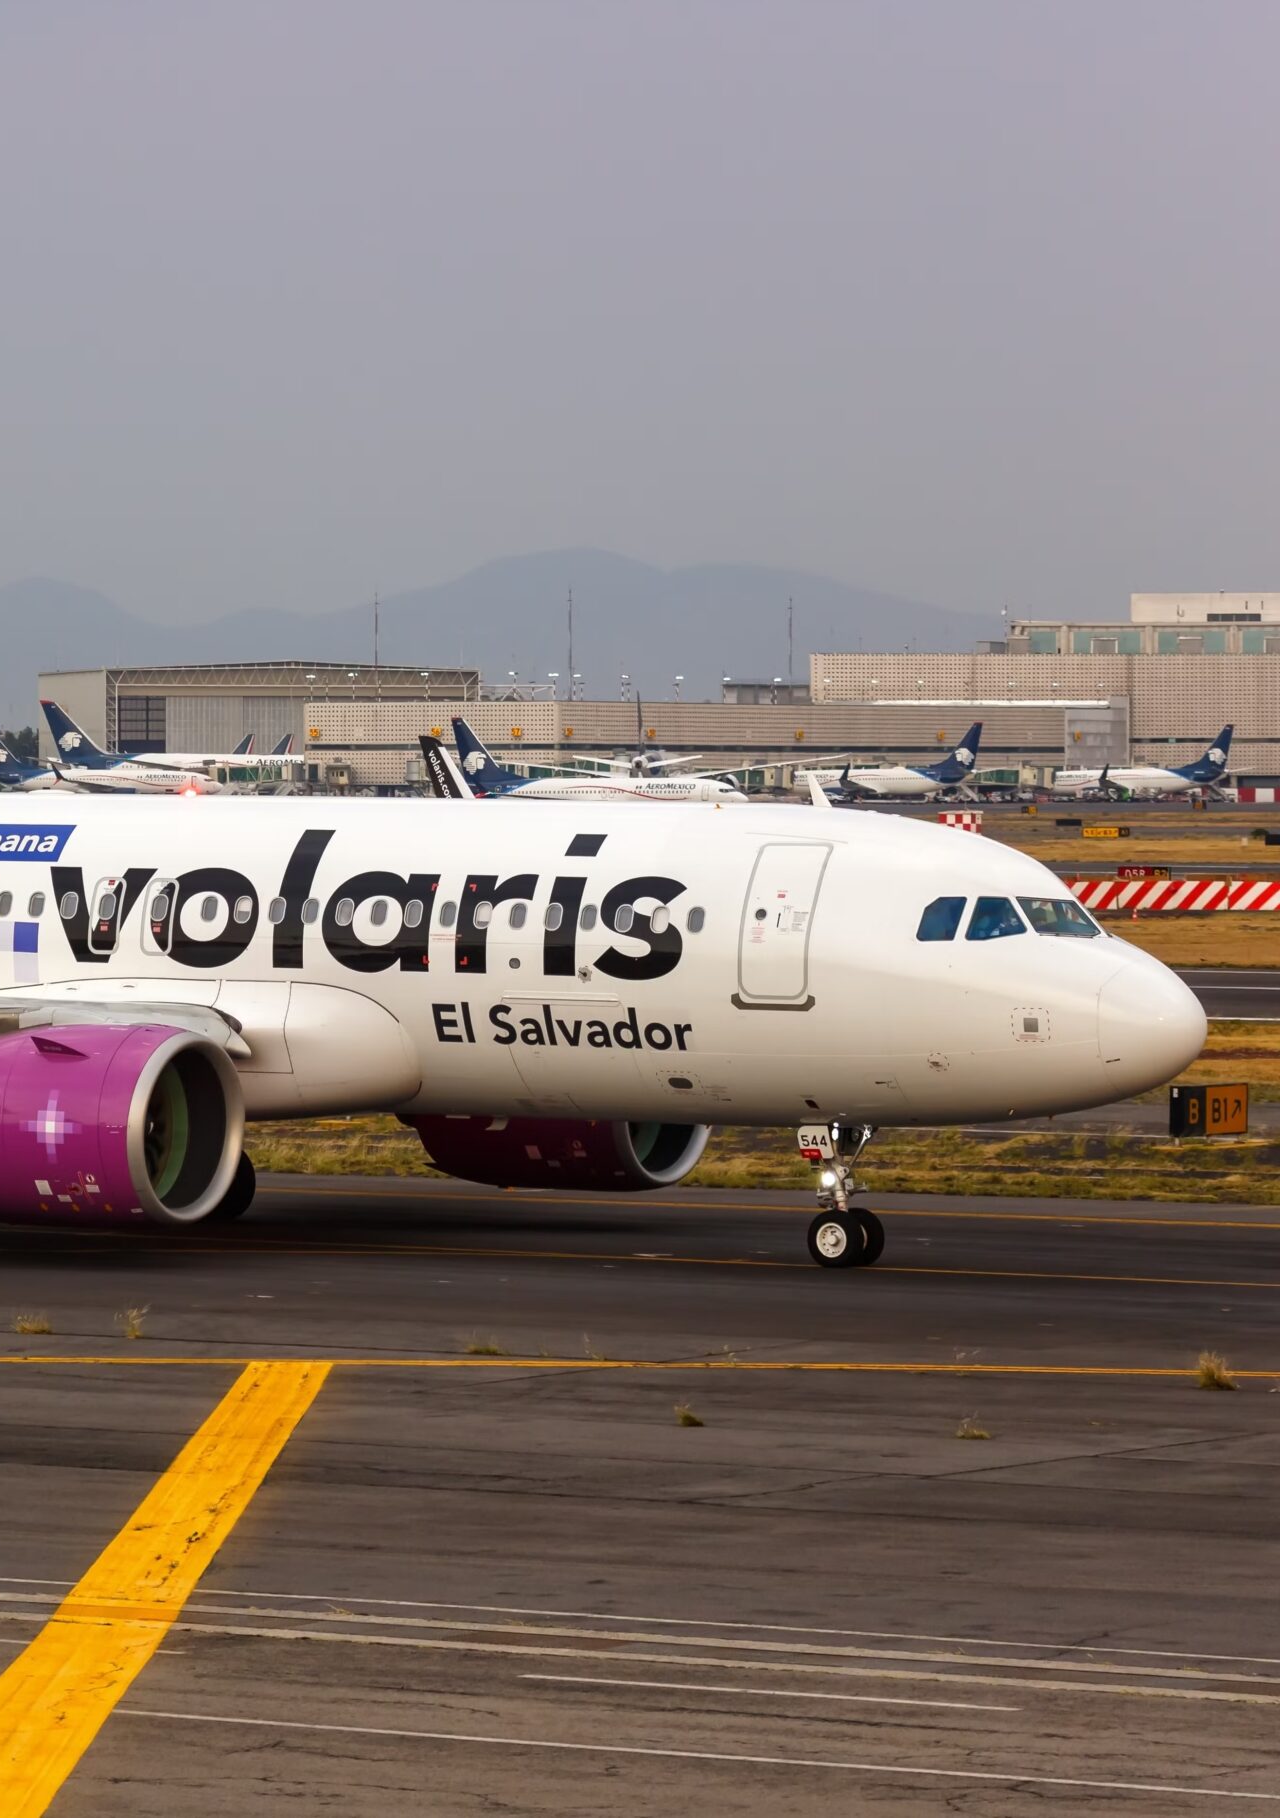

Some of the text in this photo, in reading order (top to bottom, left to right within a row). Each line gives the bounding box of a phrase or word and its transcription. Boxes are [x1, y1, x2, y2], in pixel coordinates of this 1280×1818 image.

[50, 829, 688, 981] volaris
[432, 1003, 693, 1051] El Salvador
[1187, 1097, 1228, 1125] B B1
[800, 1135, 827, 1147] 544
